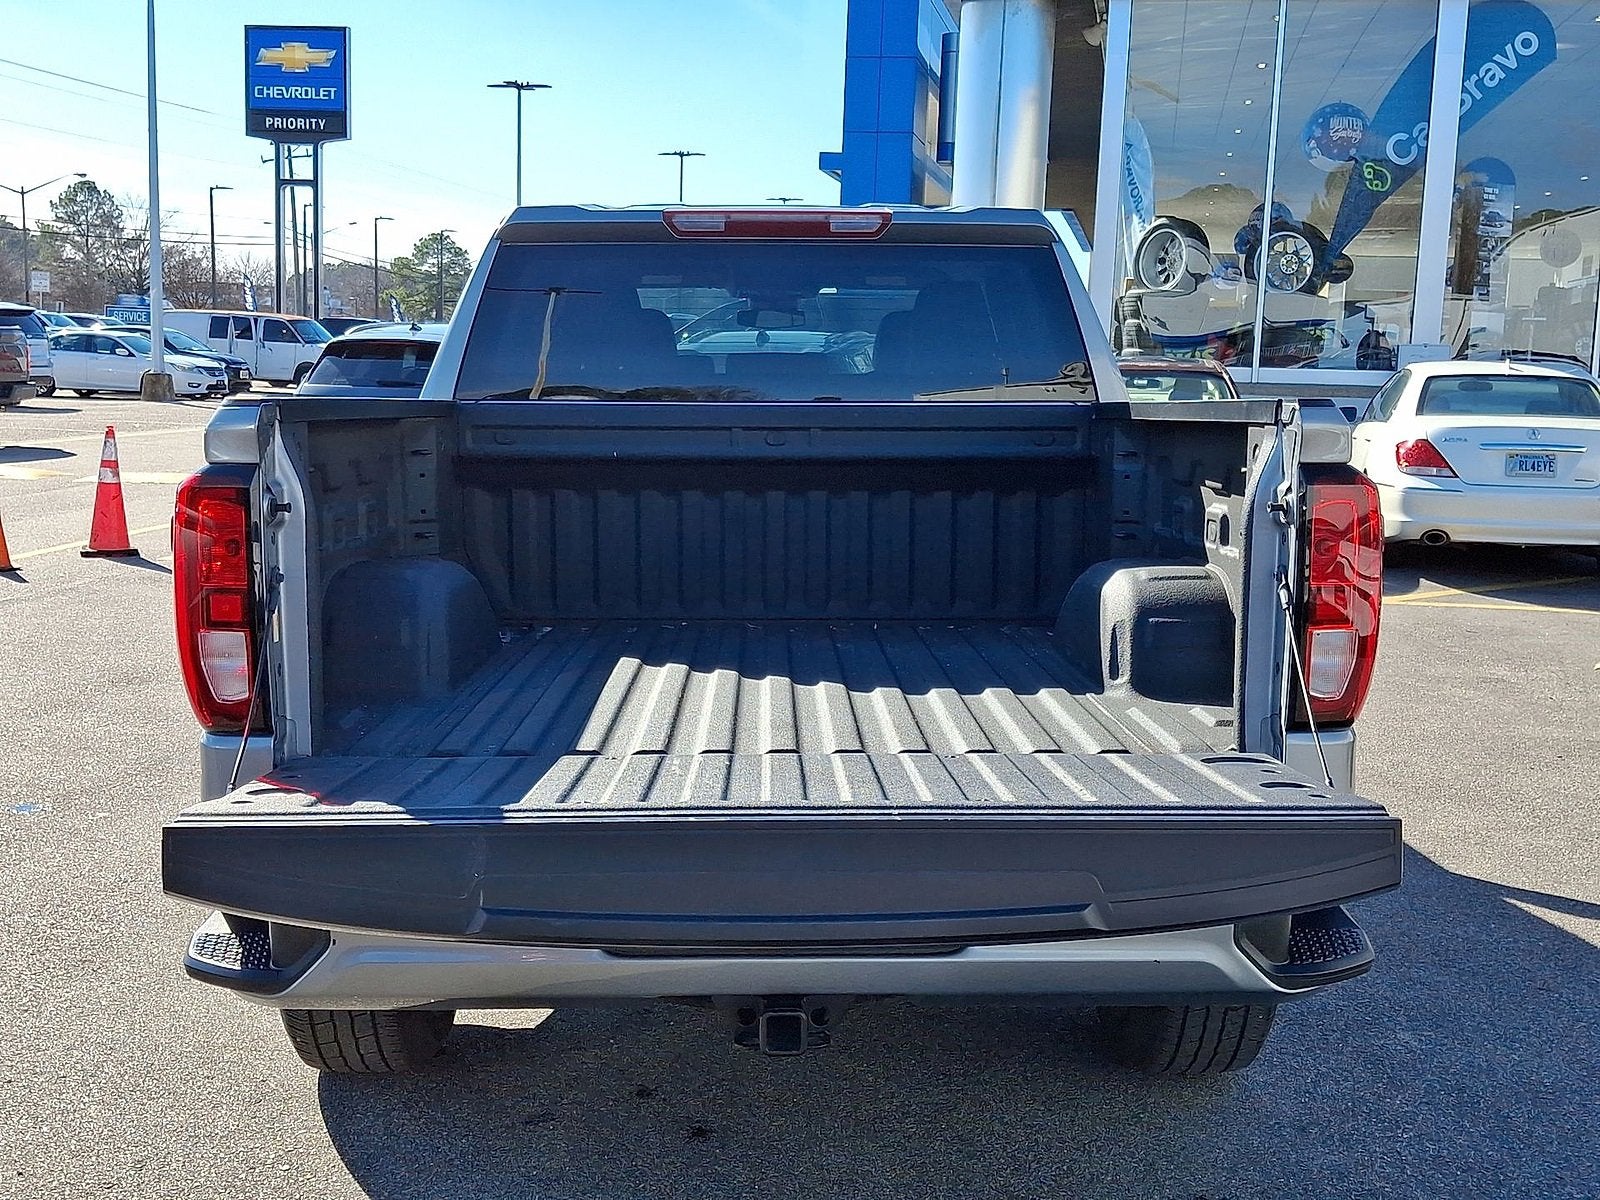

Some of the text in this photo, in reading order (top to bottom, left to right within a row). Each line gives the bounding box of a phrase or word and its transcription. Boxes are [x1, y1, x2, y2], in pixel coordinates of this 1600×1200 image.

[254, 85, 337, 99] CHEVROLET
[1386, 31, 1539, 166] Caravo
[265, 117, 326, 130] PRIORITY
[113, 310, 148, 322] SERVICE
[1518, 459, 1555, 473] RL4EYE
